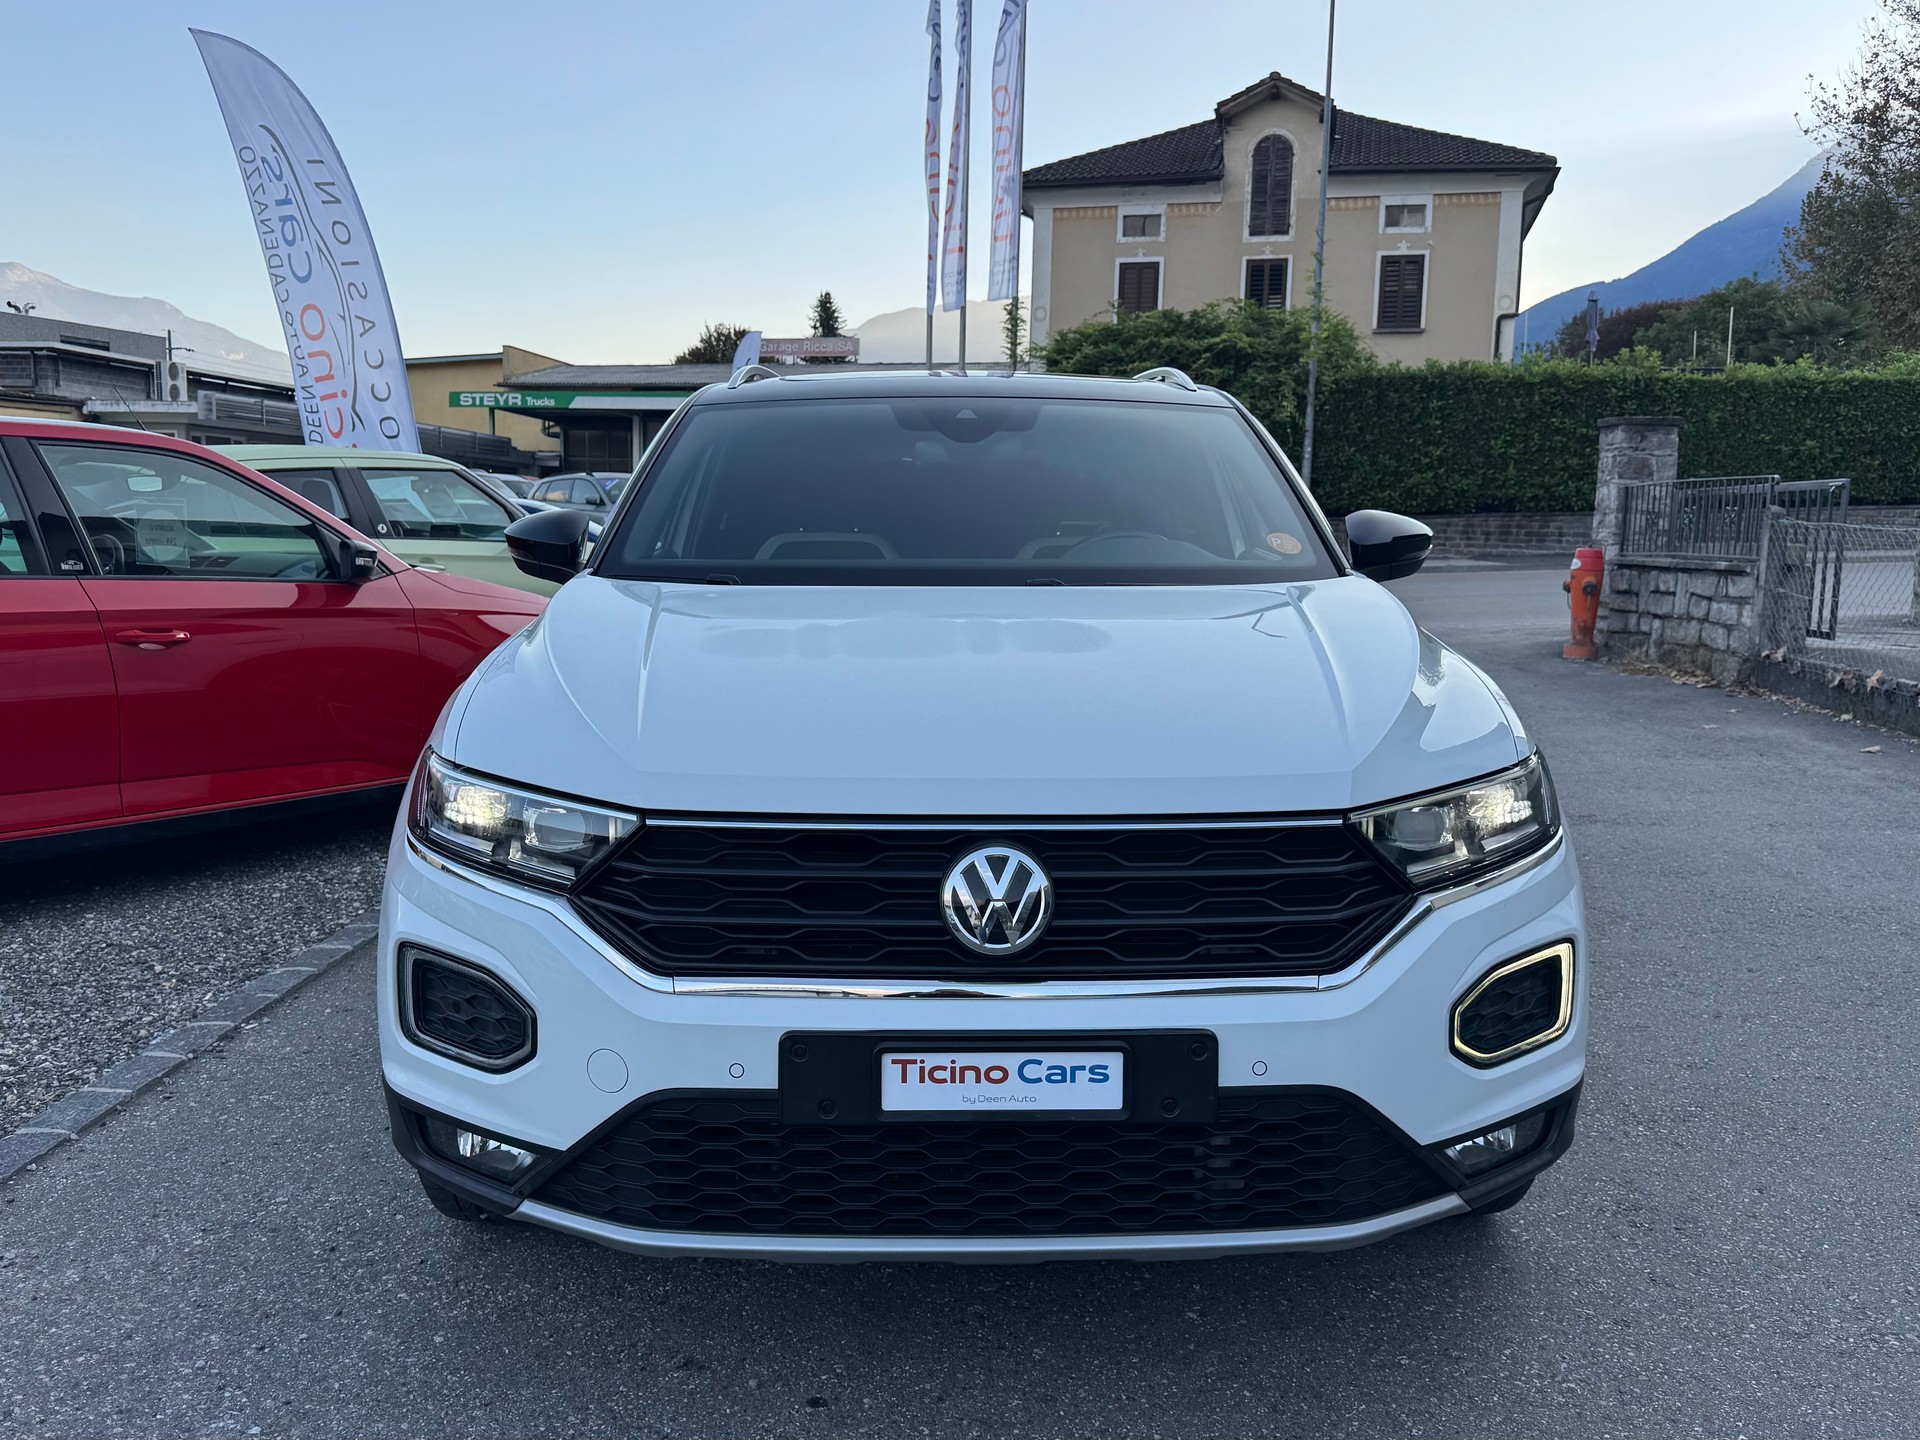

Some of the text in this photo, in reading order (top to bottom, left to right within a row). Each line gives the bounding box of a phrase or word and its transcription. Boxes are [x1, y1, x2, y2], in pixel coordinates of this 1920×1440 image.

[760, 341, 854, 354] Garage Ricca SA
[460, 393, 556, 406] STEYR Trucks
[944, 847, 1050, 953] VW
[890, 1058, 1110, 1085] Ticino Cars
[962, 1094, 1037, 1104] by Deen Auto
